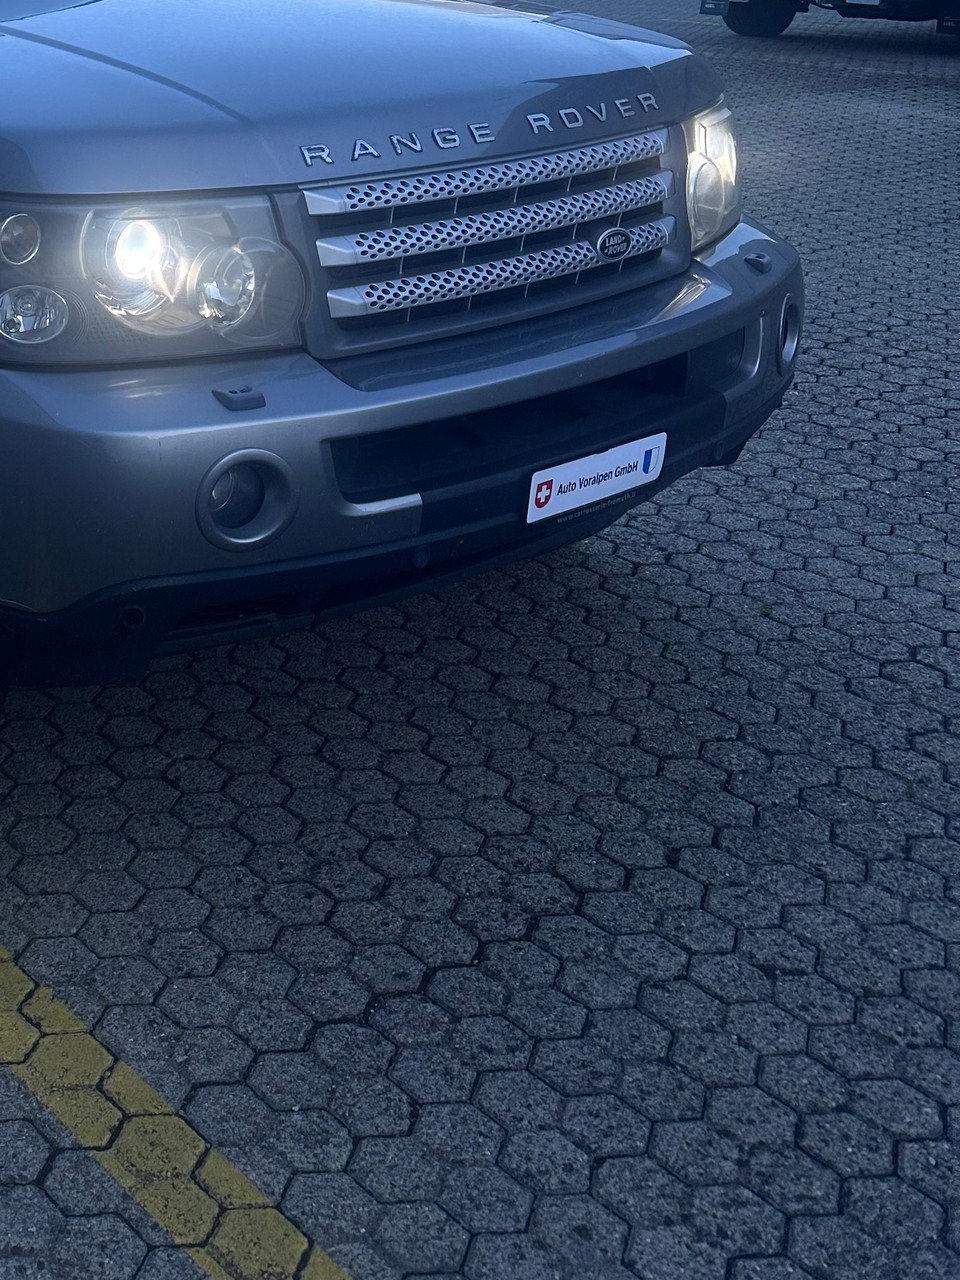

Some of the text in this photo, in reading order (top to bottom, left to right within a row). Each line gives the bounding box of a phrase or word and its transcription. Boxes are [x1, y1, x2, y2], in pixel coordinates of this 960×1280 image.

[299, 92, 660, 166] RANGE ROVER
[605, 234, 622, 247] LAND
[607, 242, 628, 256] ROVER
[556, 460, 639, 496] Auto Voralpen GmbH
